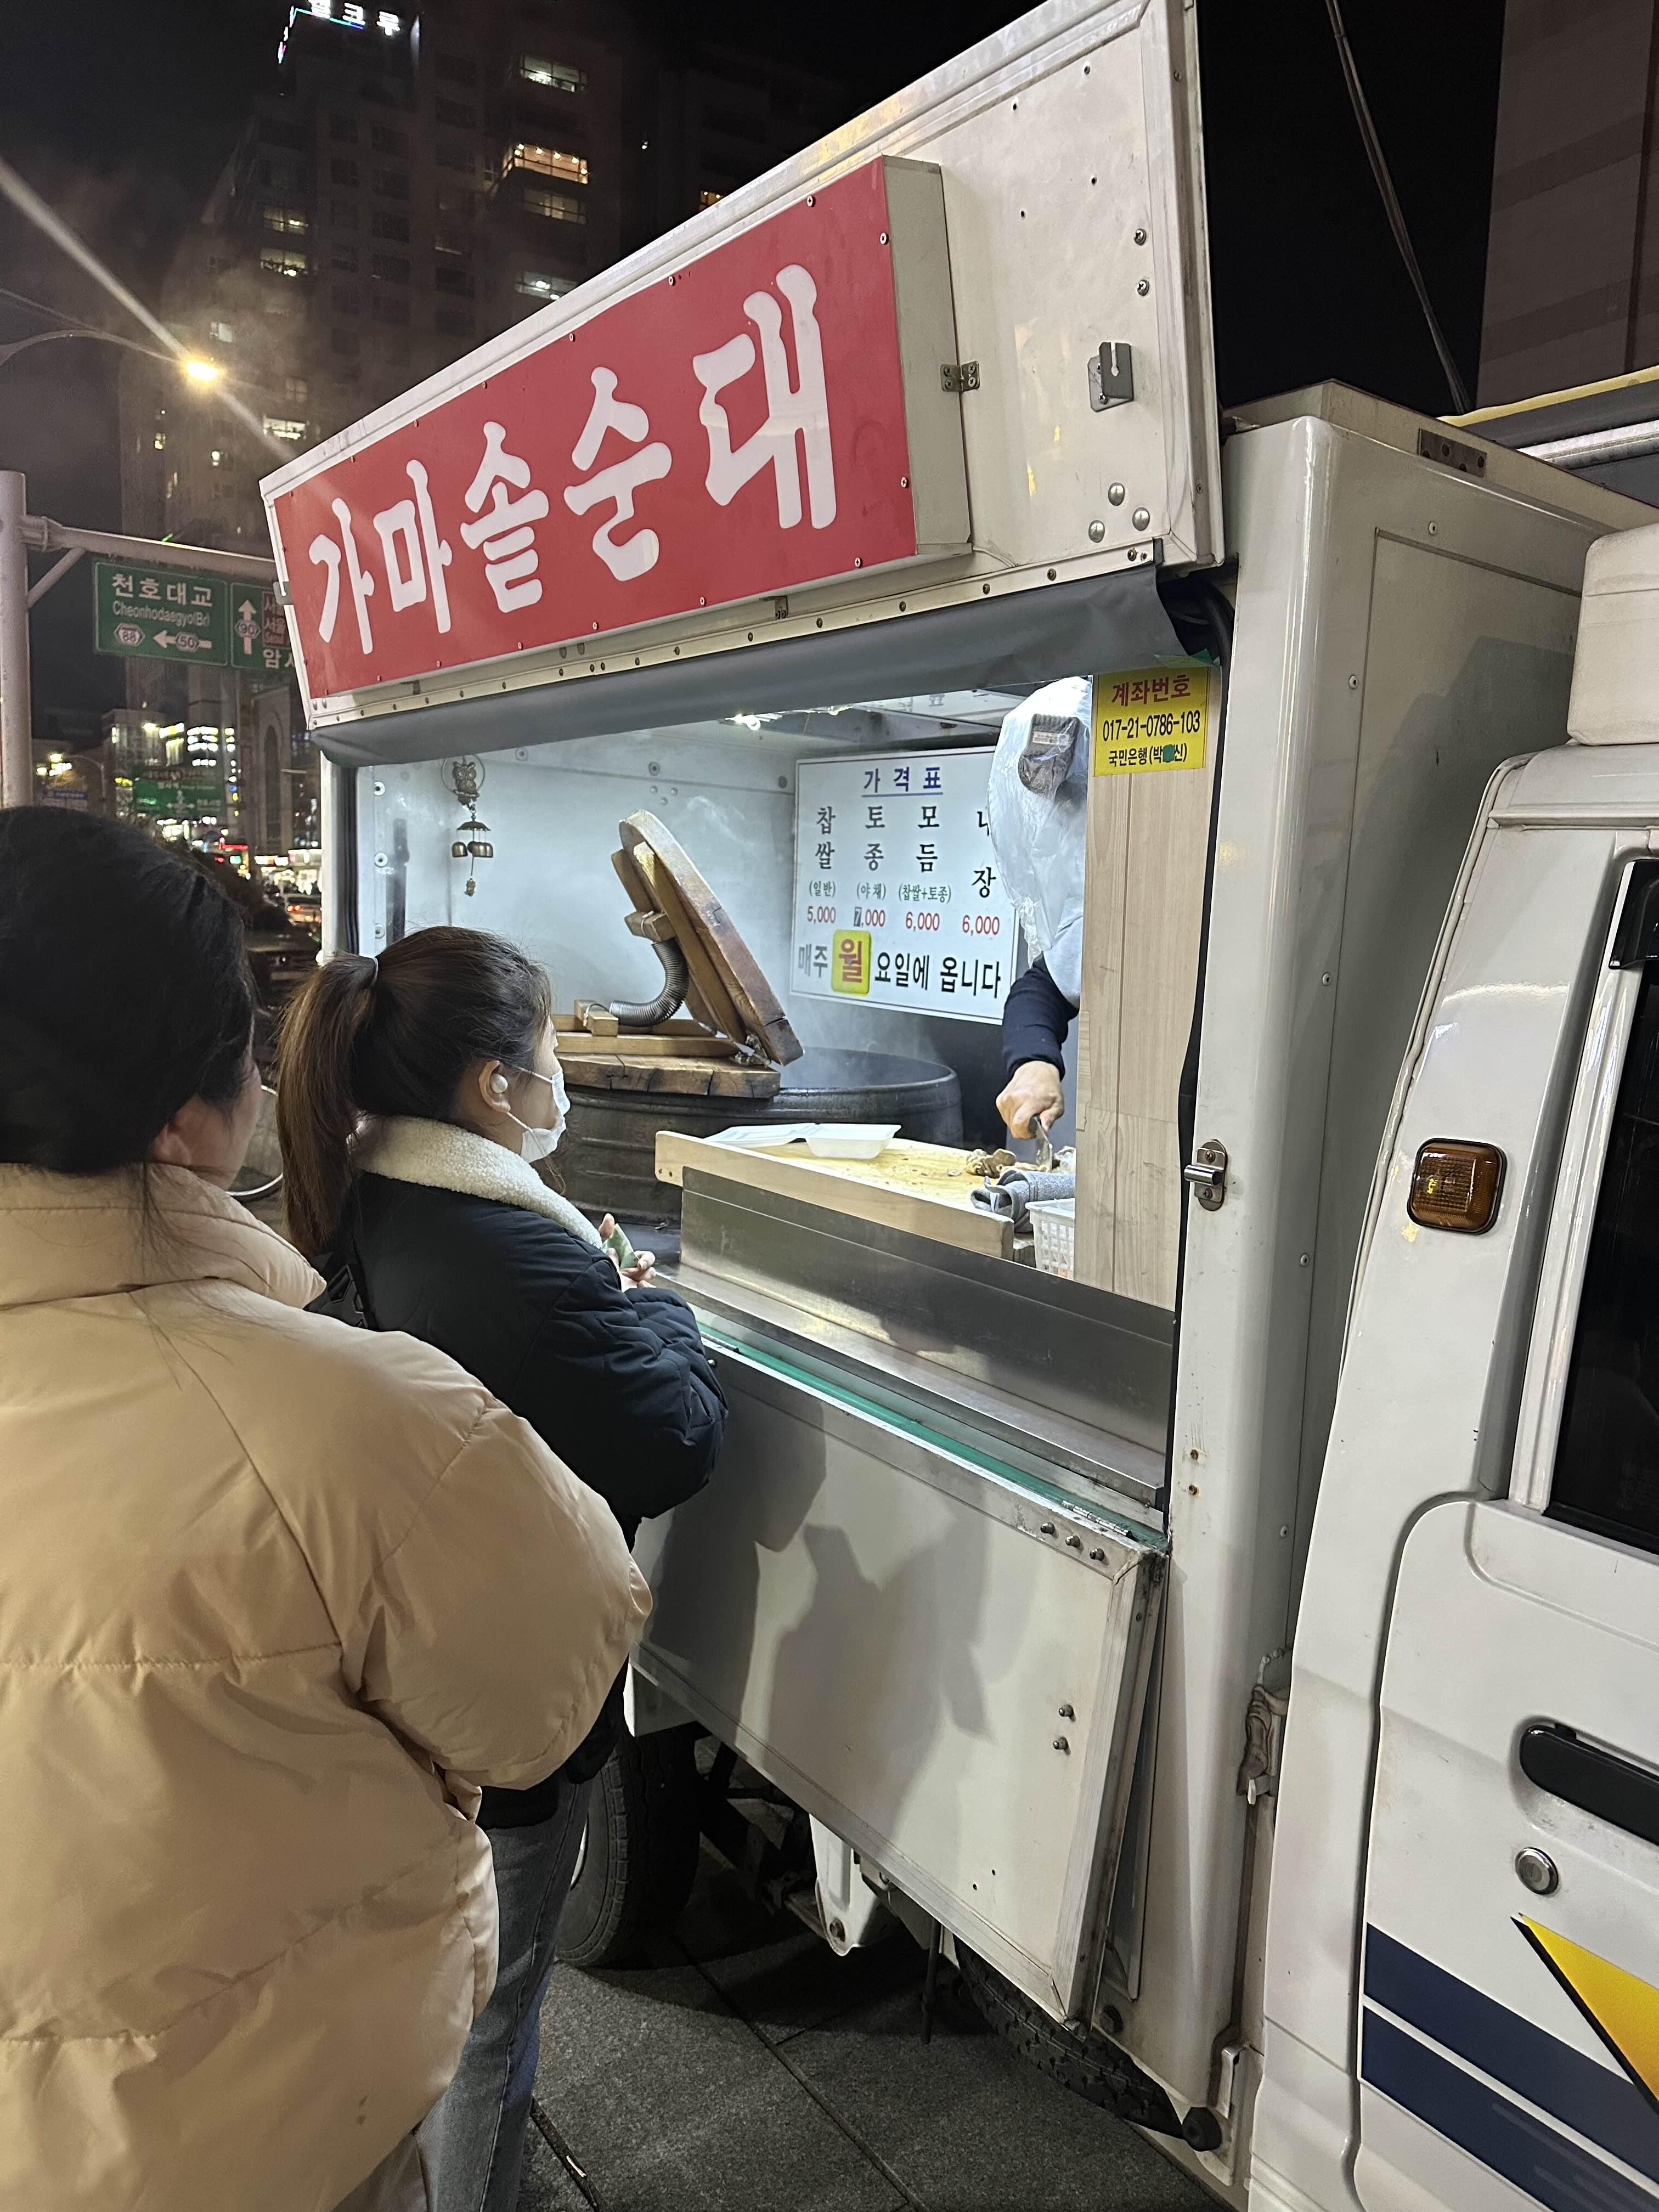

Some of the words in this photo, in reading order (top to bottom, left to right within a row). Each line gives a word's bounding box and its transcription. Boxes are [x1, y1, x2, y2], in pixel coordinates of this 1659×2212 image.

[309, 264, 837, 654] 가마솥순대
[112, 573, 212, 607] 천호대교
[122, 631, 137, 642] 88
[180, 636, 194, 647] 50
[240, 623, 255, 634] 90
[1111, 674, 1190, 707] 계좌번호
[1103, 710, 1200, 741] 017-21-0786-103
[809, 881, 836, 898] (일반)
[899, 883, 951, 904] (찹쌀+토종)
[807, 906, 836, 924] 5,000
[854, 906, 885, 927] 7,000
[906, 911, 940, 932] 6,000
[962, 915, 1000, 936] 6,000
[798, 944, 828, 978] 매주
[940, 957, 1001, 998] 옵니다
